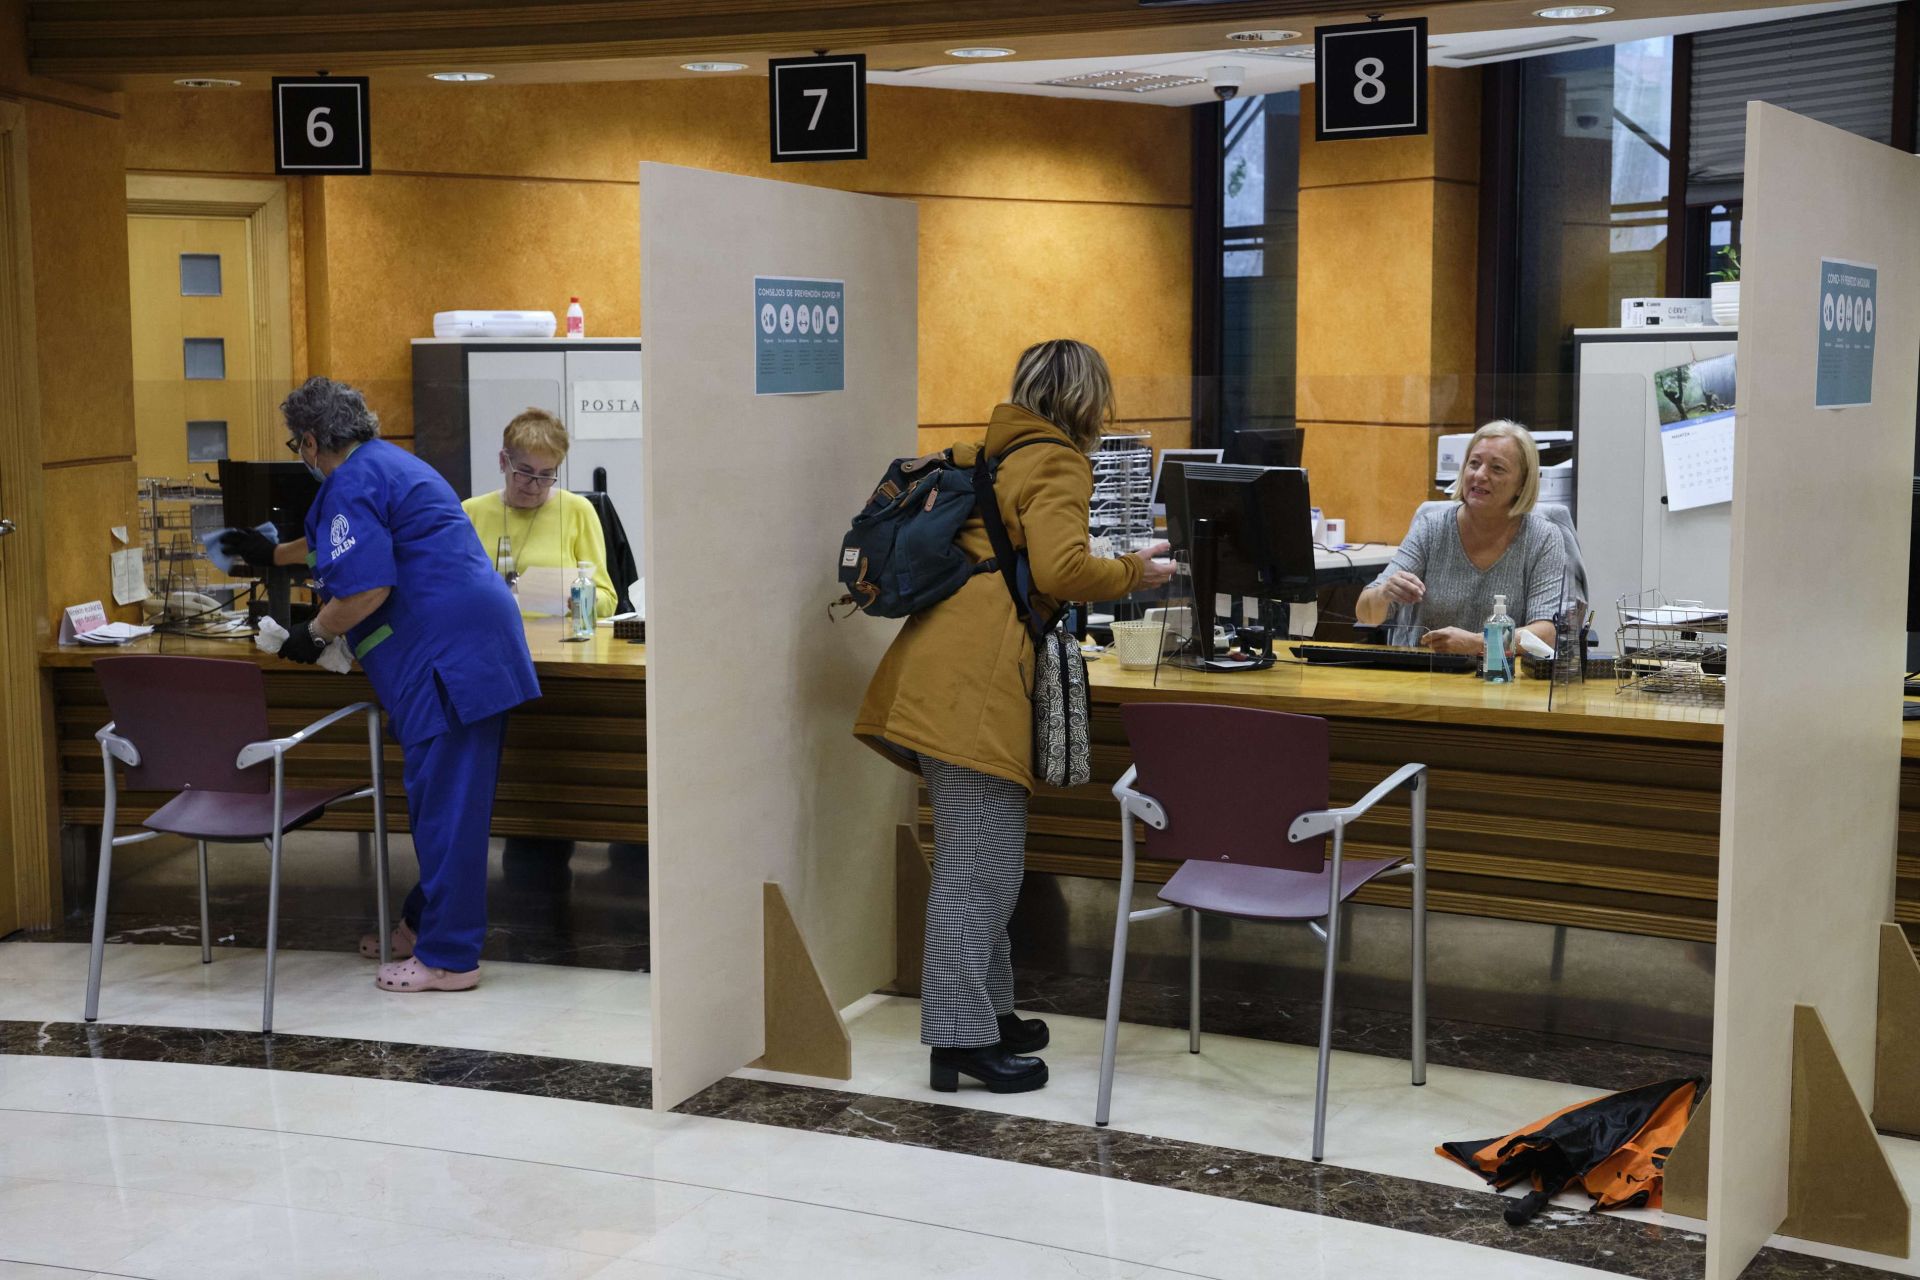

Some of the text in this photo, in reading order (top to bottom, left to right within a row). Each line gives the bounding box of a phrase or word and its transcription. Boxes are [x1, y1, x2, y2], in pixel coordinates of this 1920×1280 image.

[1354, 57, 1385, 104] 8
[803, 88, 827, 130] 7
[307, 107, 333, 147] 6
[758, 287, 785, 297] CONSEJOS
[786, 288, 793, 297] DE
[582, 399, 640, 411] POSTA
[331, 536, 356, 560] EULEN
